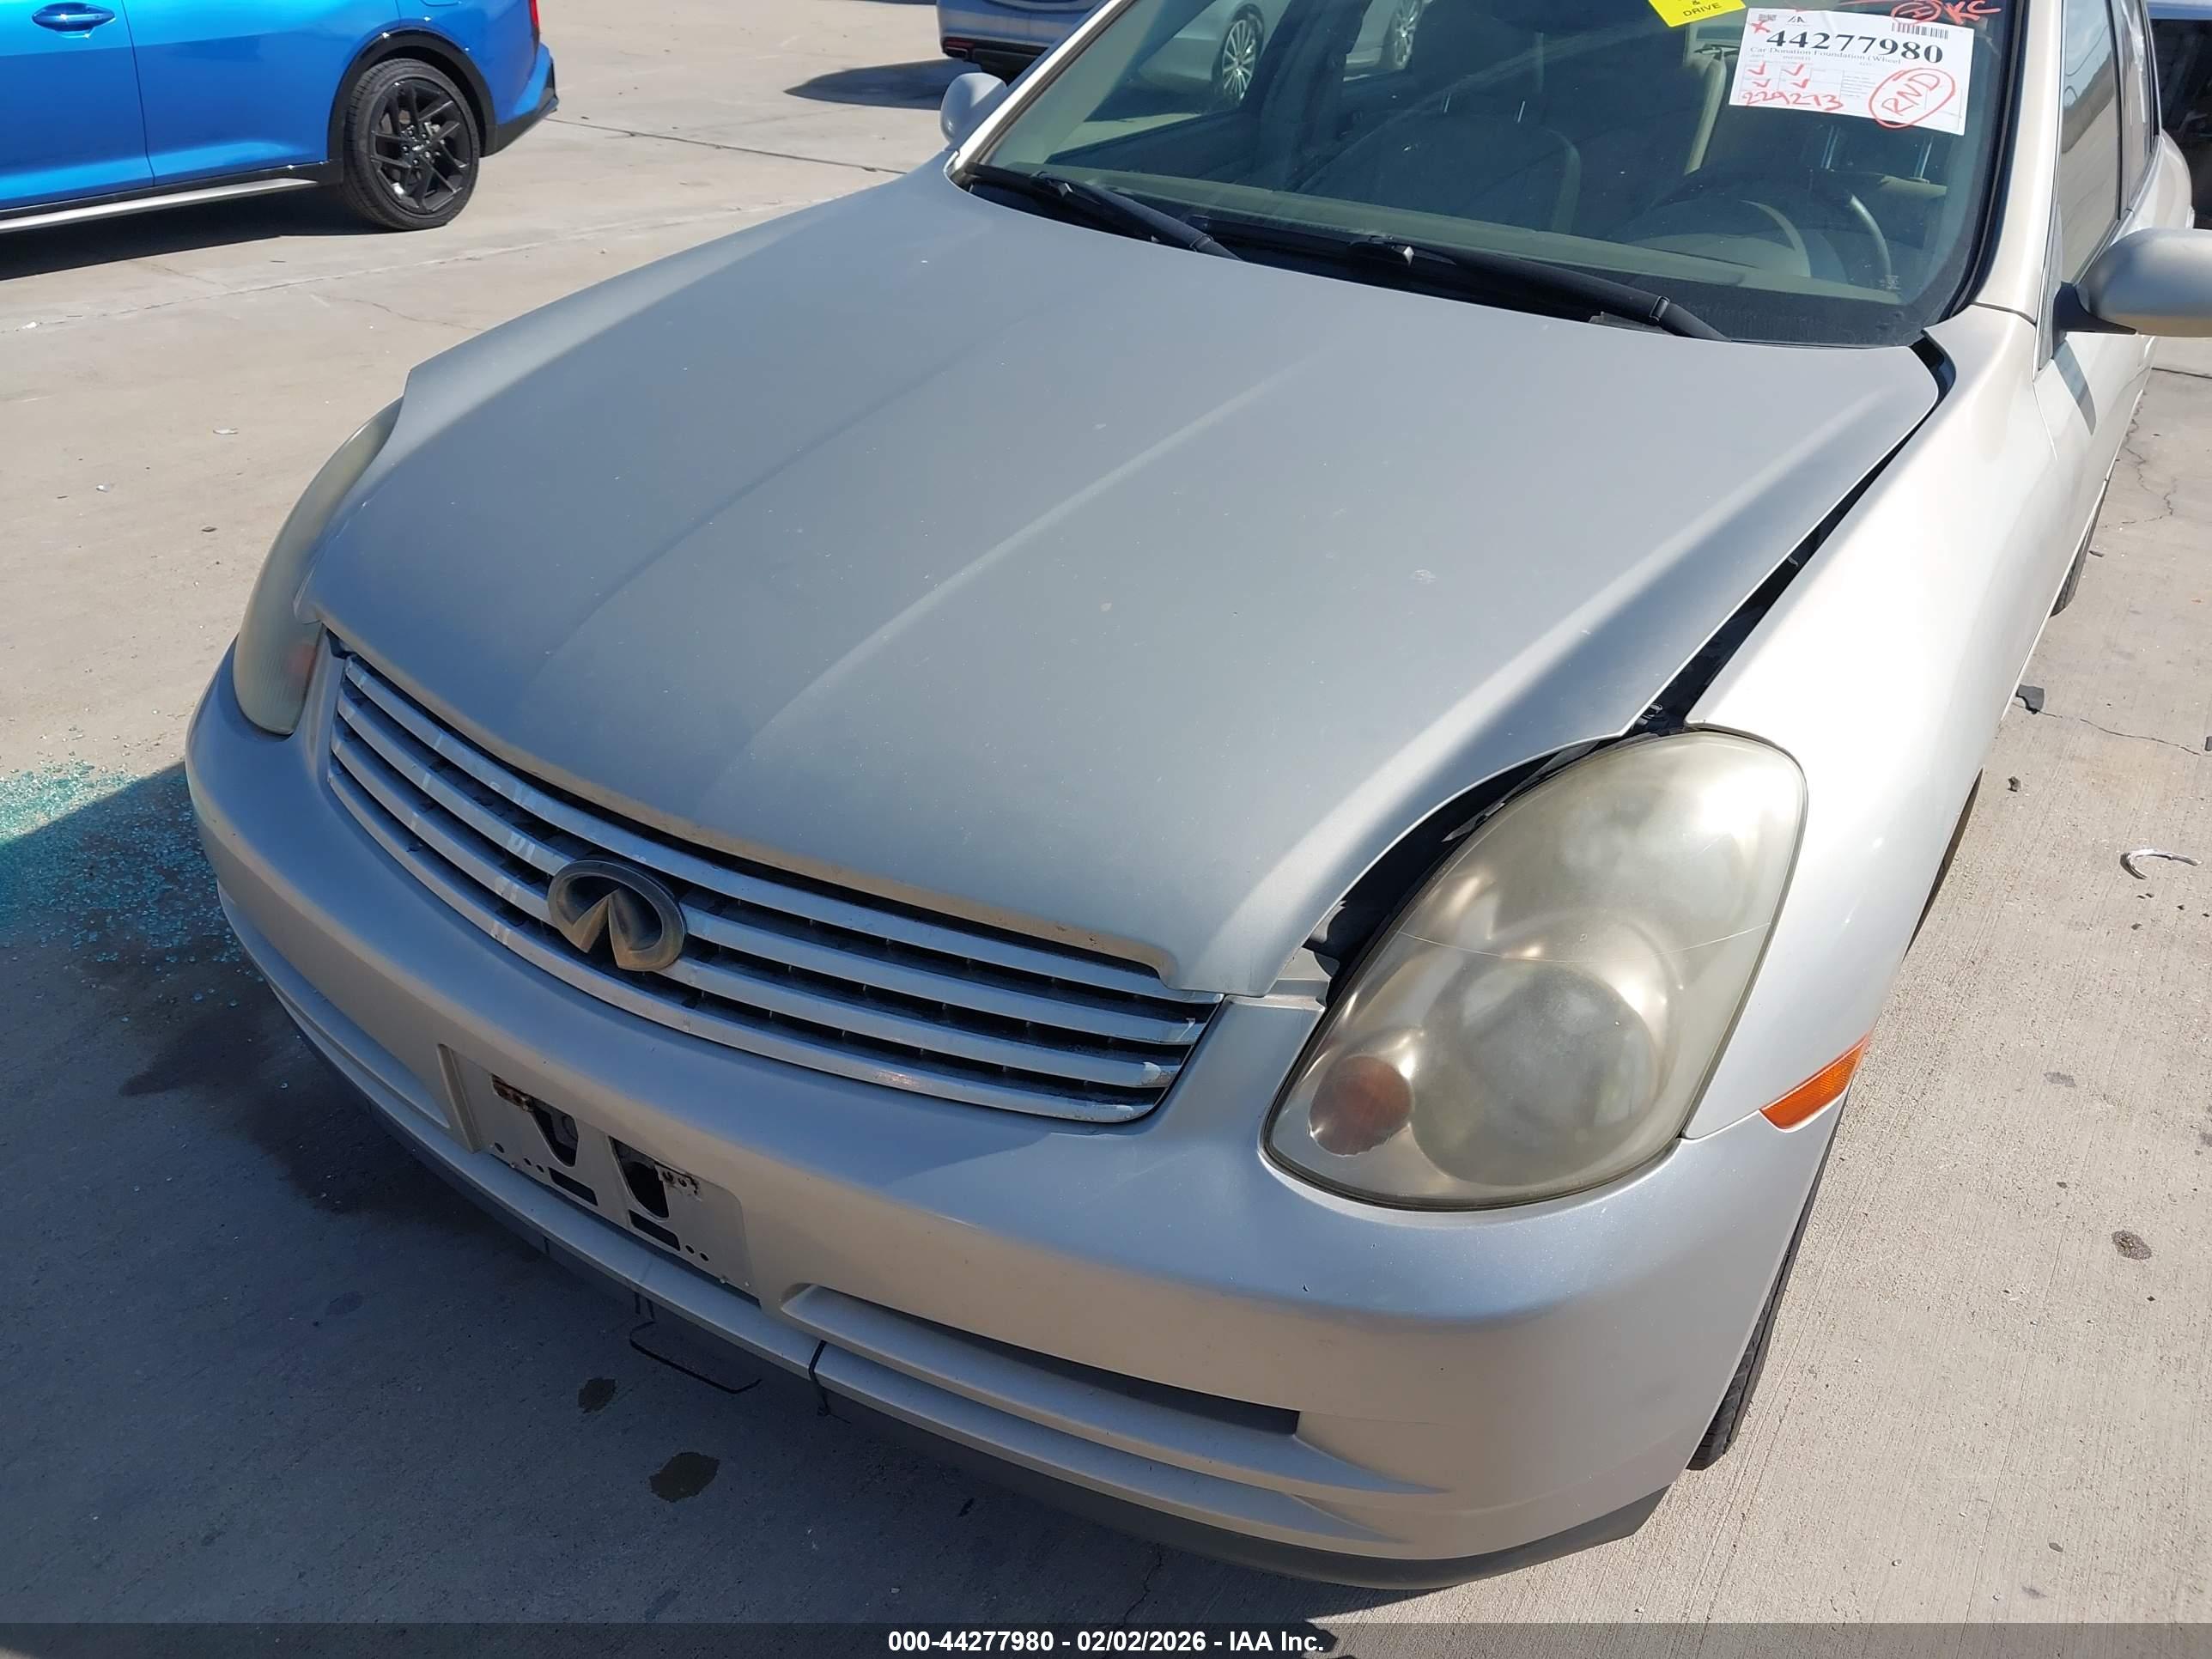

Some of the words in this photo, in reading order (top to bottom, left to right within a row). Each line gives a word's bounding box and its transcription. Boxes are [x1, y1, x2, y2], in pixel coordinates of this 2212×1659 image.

[1683, 3, 1722, 17] DRIVE
[1765, 29, 1943, 64] 44277980
[1770, 47, 1812, 56] Donation
[1814, 51, 1866, 61] Foundation
